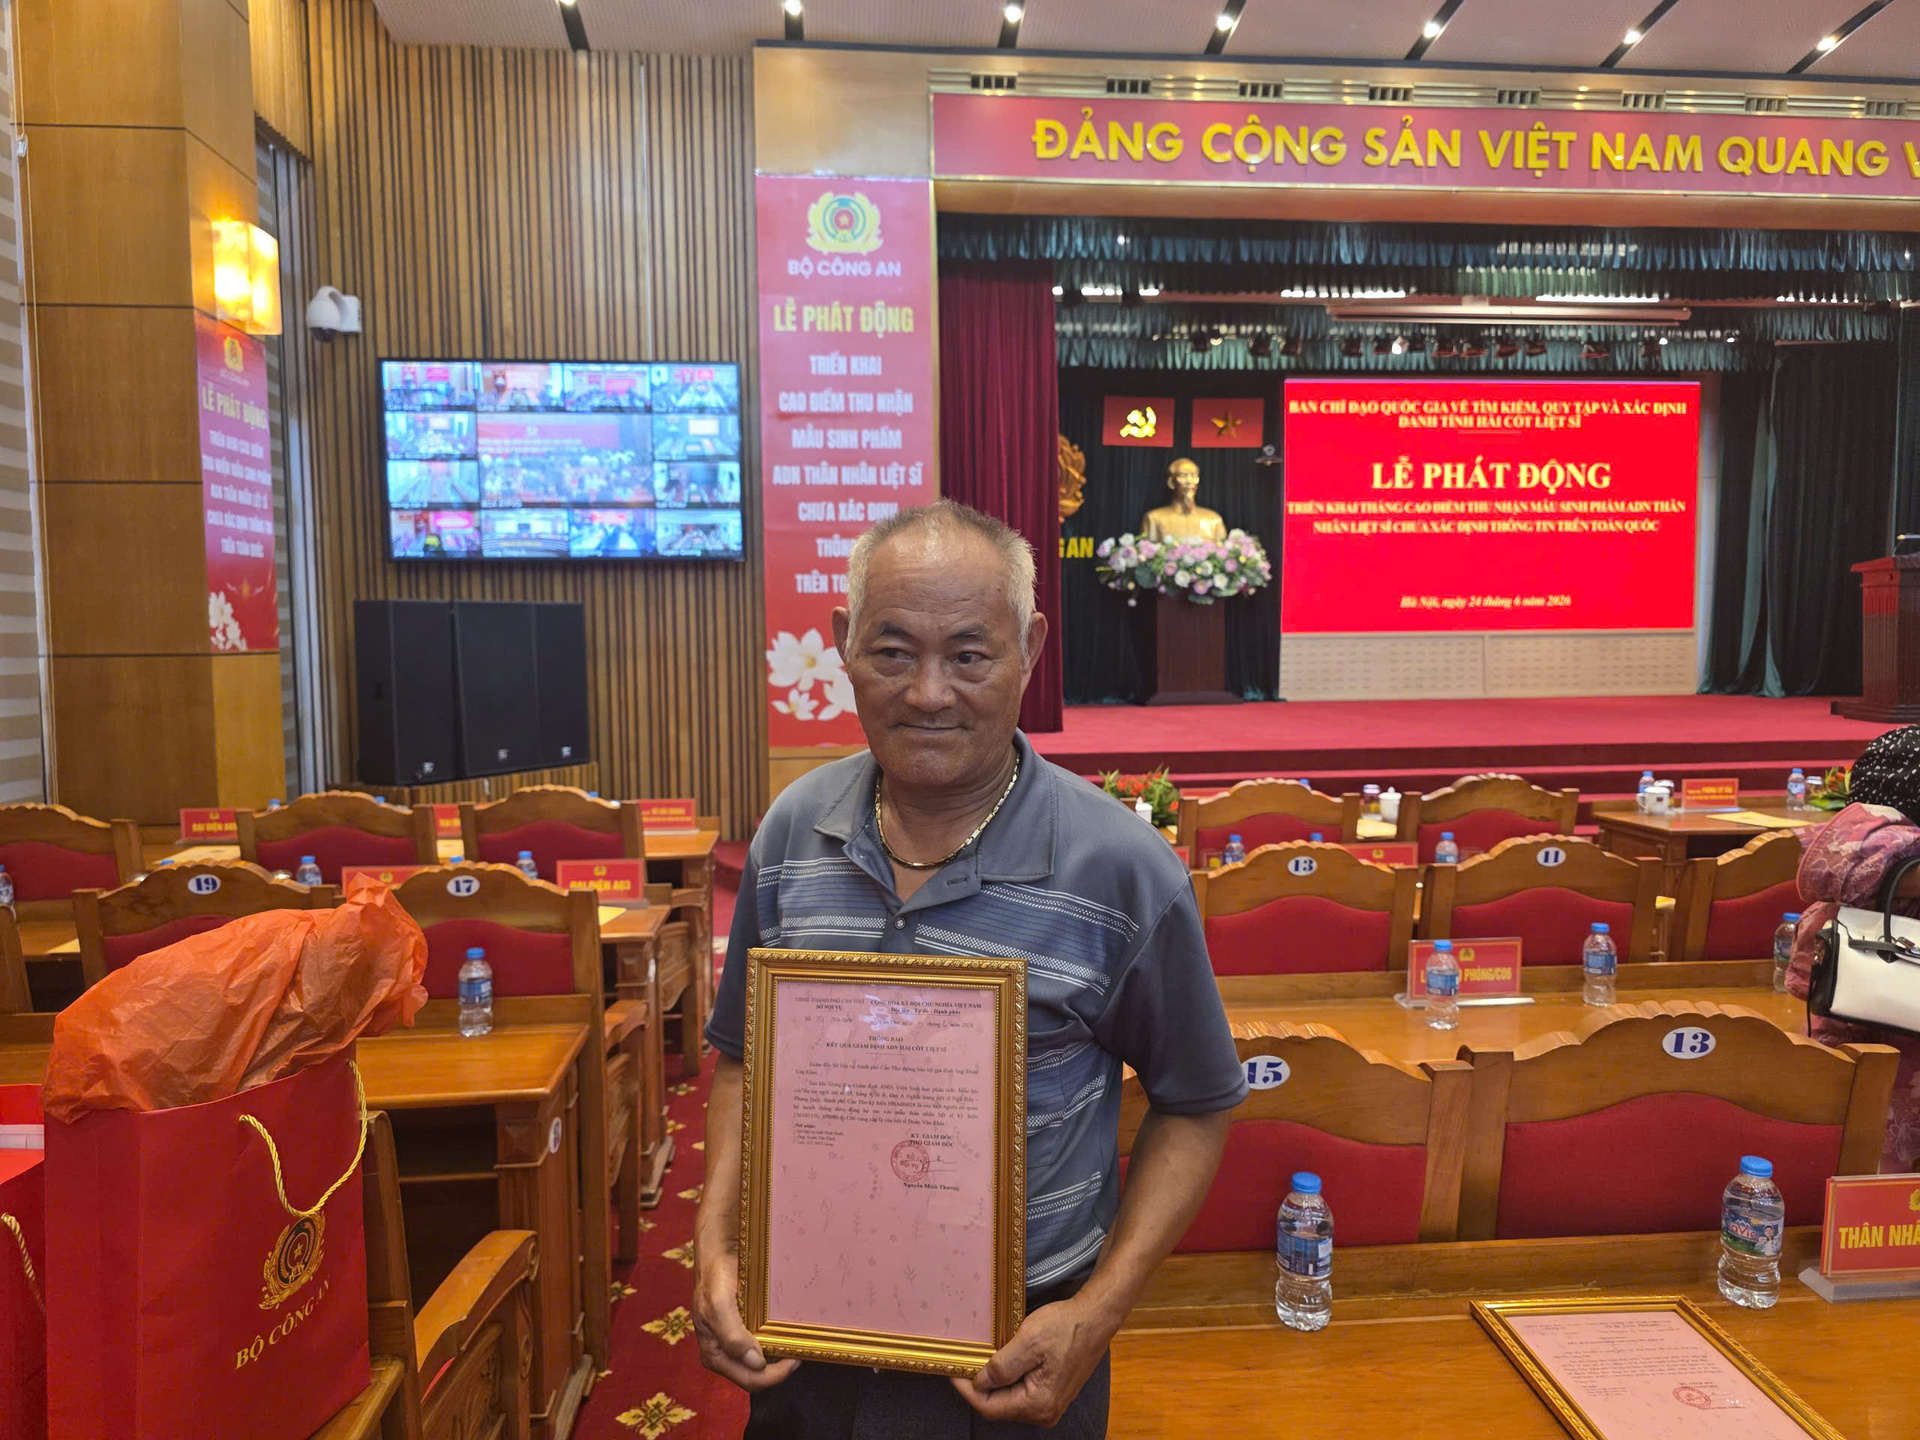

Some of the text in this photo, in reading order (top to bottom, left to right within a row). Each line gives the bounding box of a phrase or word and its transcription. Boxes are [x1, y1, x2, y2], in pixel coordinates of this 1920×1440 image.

[1032, 107, 1183, 162] ĐẢNG
[1201, 115, 1347, 173] CỘNG
[1363, 113, 1462, 169] SẢN
[1480, 121, 1577, 178] VIỆT
[1590, 132, 1704, 173] NAM
[1718, 135, 1889, 177] QUANG
[788, 256, 902, 279] BỘ CÔNG AN
[774, 297, 914, 338] LỄ PHÁT ĐỘNG
[1371, 455, 1612, 495] LỄ PHÁT ĐỘNG
[816, 533, 856, 558] THÔN
[795, 569, 829, 594] TRÊN
[1294, 859, 1314, 872] 13
[196, 877, 218, 892] 19
[453, 879, 474, 893] 17
[1670, 1032, 1710, 1054] 13
[1246, 1061, 1283, 1084] 15
[1839, 1221, 1884, 1249] THÂN
[235, 1334, 265, 1370] BỘ
[269, 1296, 315, 1346] CÔNG
